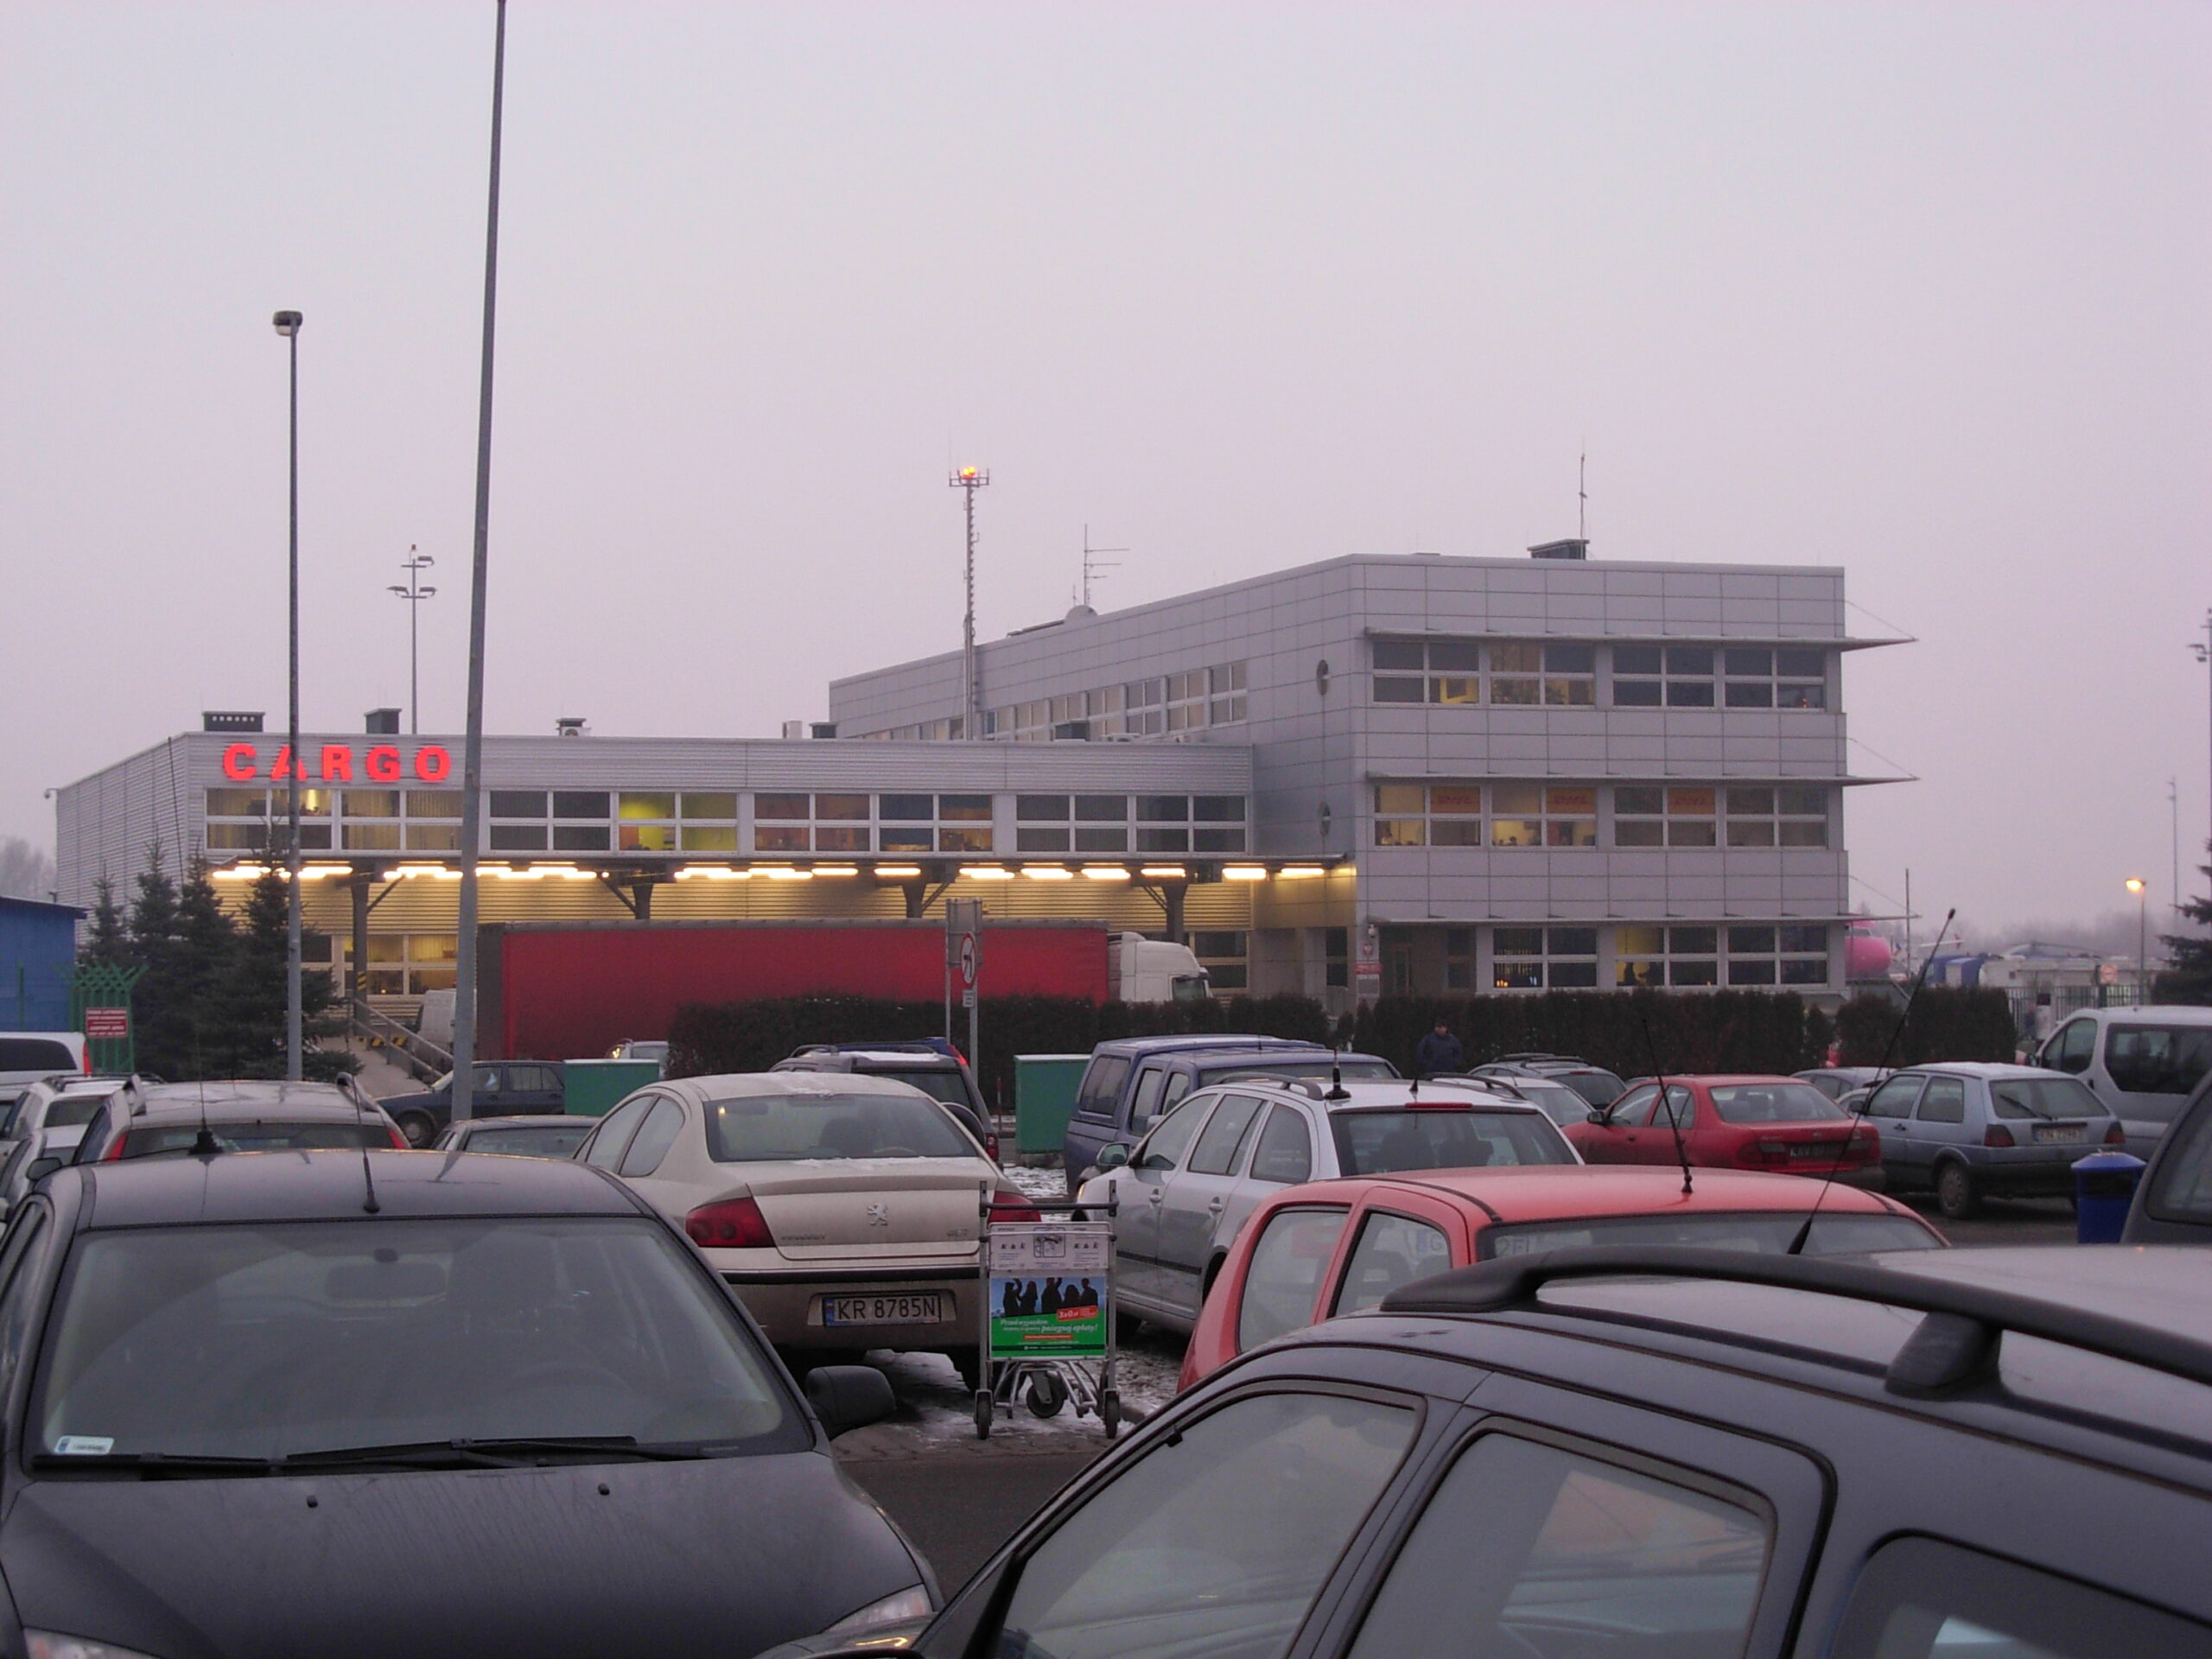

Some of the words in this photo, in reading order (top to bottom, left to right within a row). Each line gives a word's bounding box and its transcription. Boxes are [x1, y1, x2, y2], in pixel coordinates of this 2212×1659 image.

[222, 742, 452, 783] CARGO
[837, 1300, 867, 1320] KR
[874, 1297, 935, 1319] 8785N
